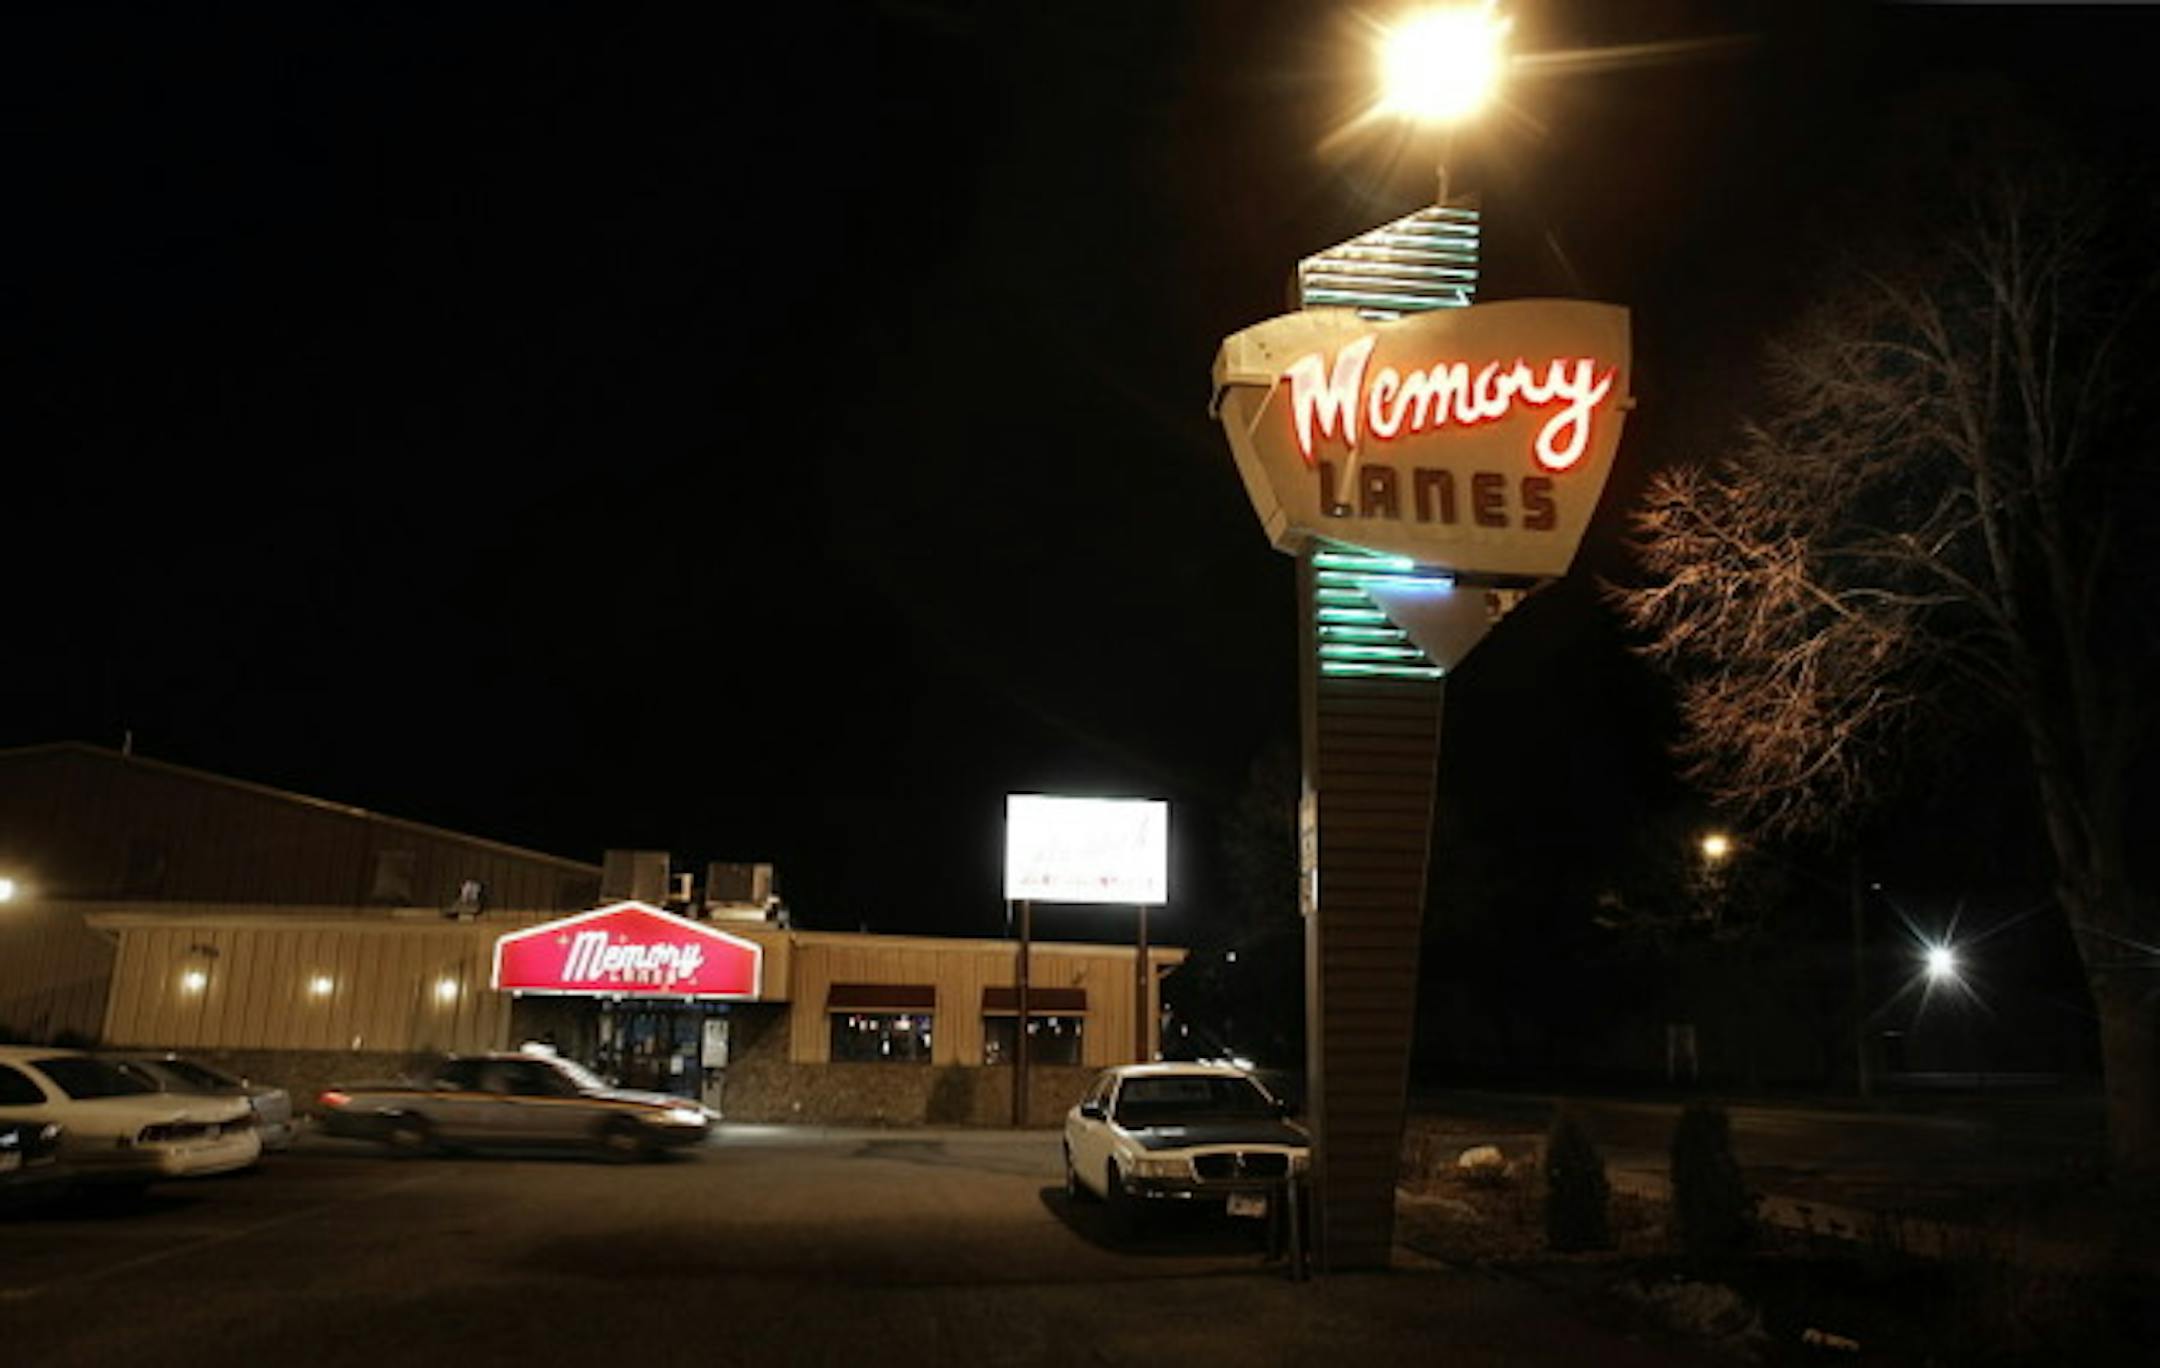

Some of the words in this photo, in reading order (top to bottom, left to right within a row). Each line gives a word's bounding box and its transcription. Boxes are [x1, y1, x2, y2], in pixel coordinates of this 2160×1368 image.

[1284, 334, 1614, 470] Memory
[1319, 461, 1559, 532] LANES
[561, 931, 705, 982] Memory
